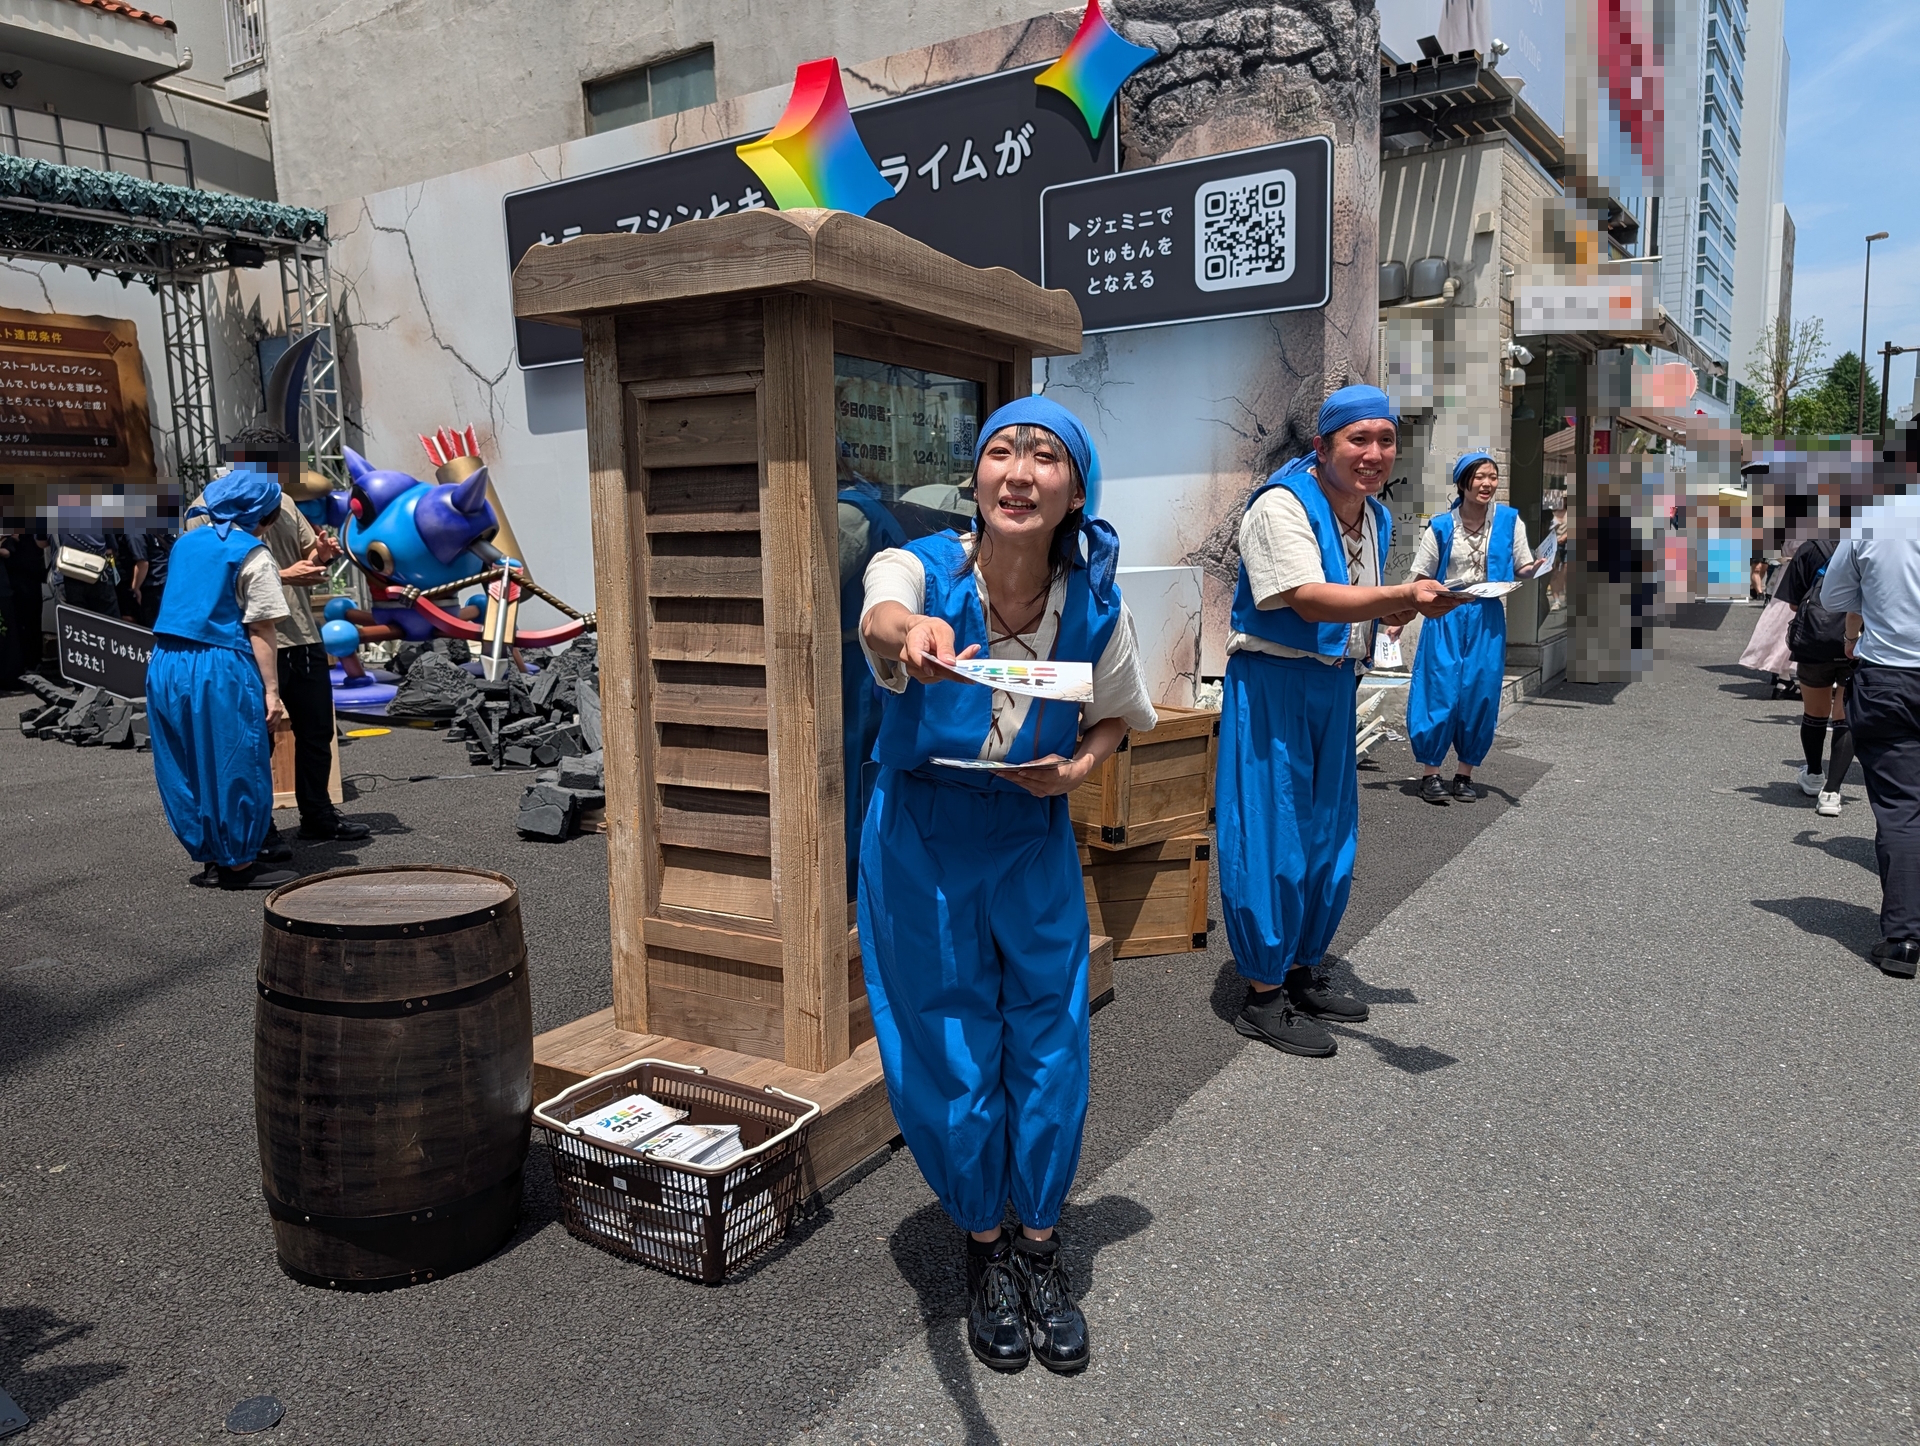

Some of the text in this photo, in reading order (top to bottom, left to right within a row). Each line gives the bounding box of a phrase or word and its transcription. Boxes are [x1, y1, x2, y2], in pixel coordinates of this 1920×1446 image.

[1086, 206, 1173, 237] ジェミニで
[1087, 236, 1173, 267] じゅもんを
[1087, 270, 1155, 295] となえる
[0, 327, 63, 343] ト達成条件
[0, 361, 102, 376] ストールして、ログイン。
[65, 625, 106, 651] ジェミニで
[67, 648, 106, 674] となえた!
[596, 1104, 645, 1129] ジェミニ
[611, 1111, 653, 1133] クエスト
